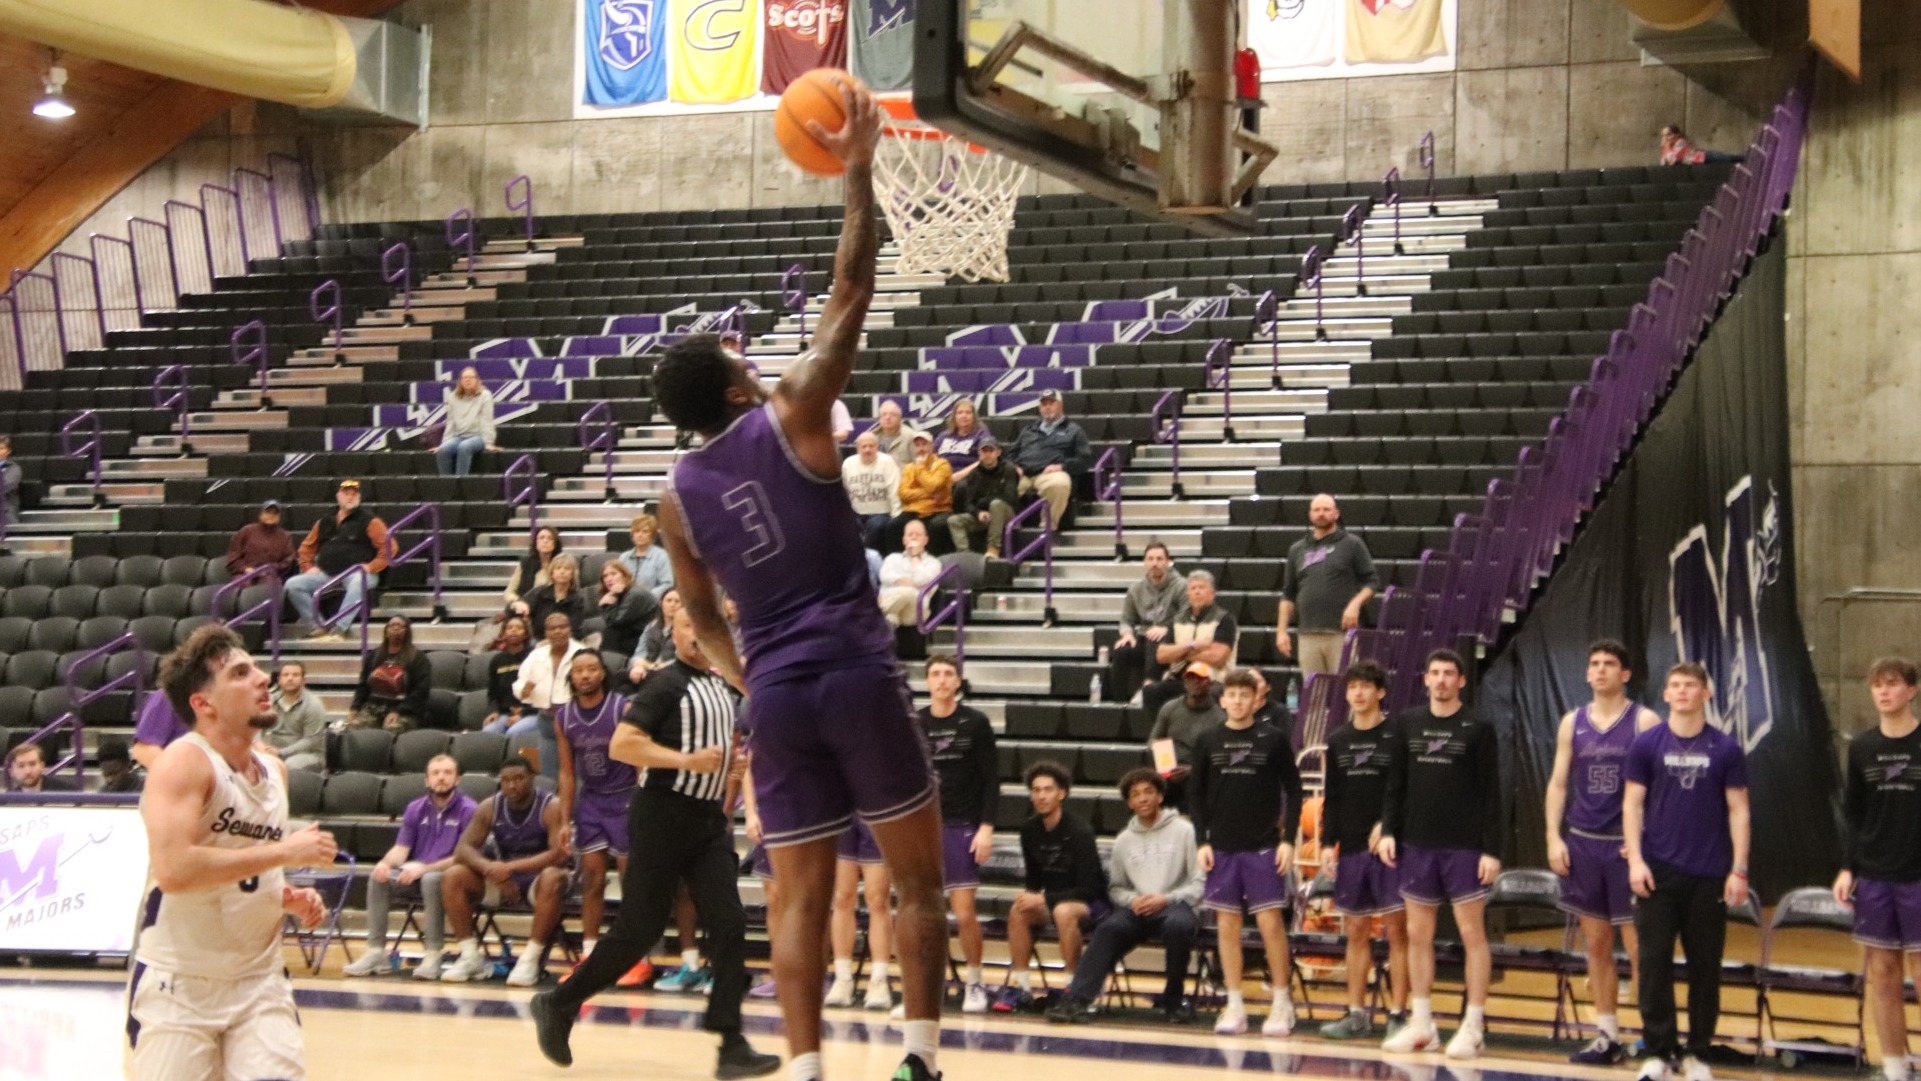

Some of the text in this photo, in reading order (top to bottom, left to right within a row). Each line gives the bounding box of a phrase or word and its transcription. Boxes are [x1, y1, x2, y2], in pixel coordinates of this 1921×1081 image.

[721, 480, 786, 569] 3
[1588, 764, 1620, 795] 55
[6, 892, 85, 932] MAJORS
